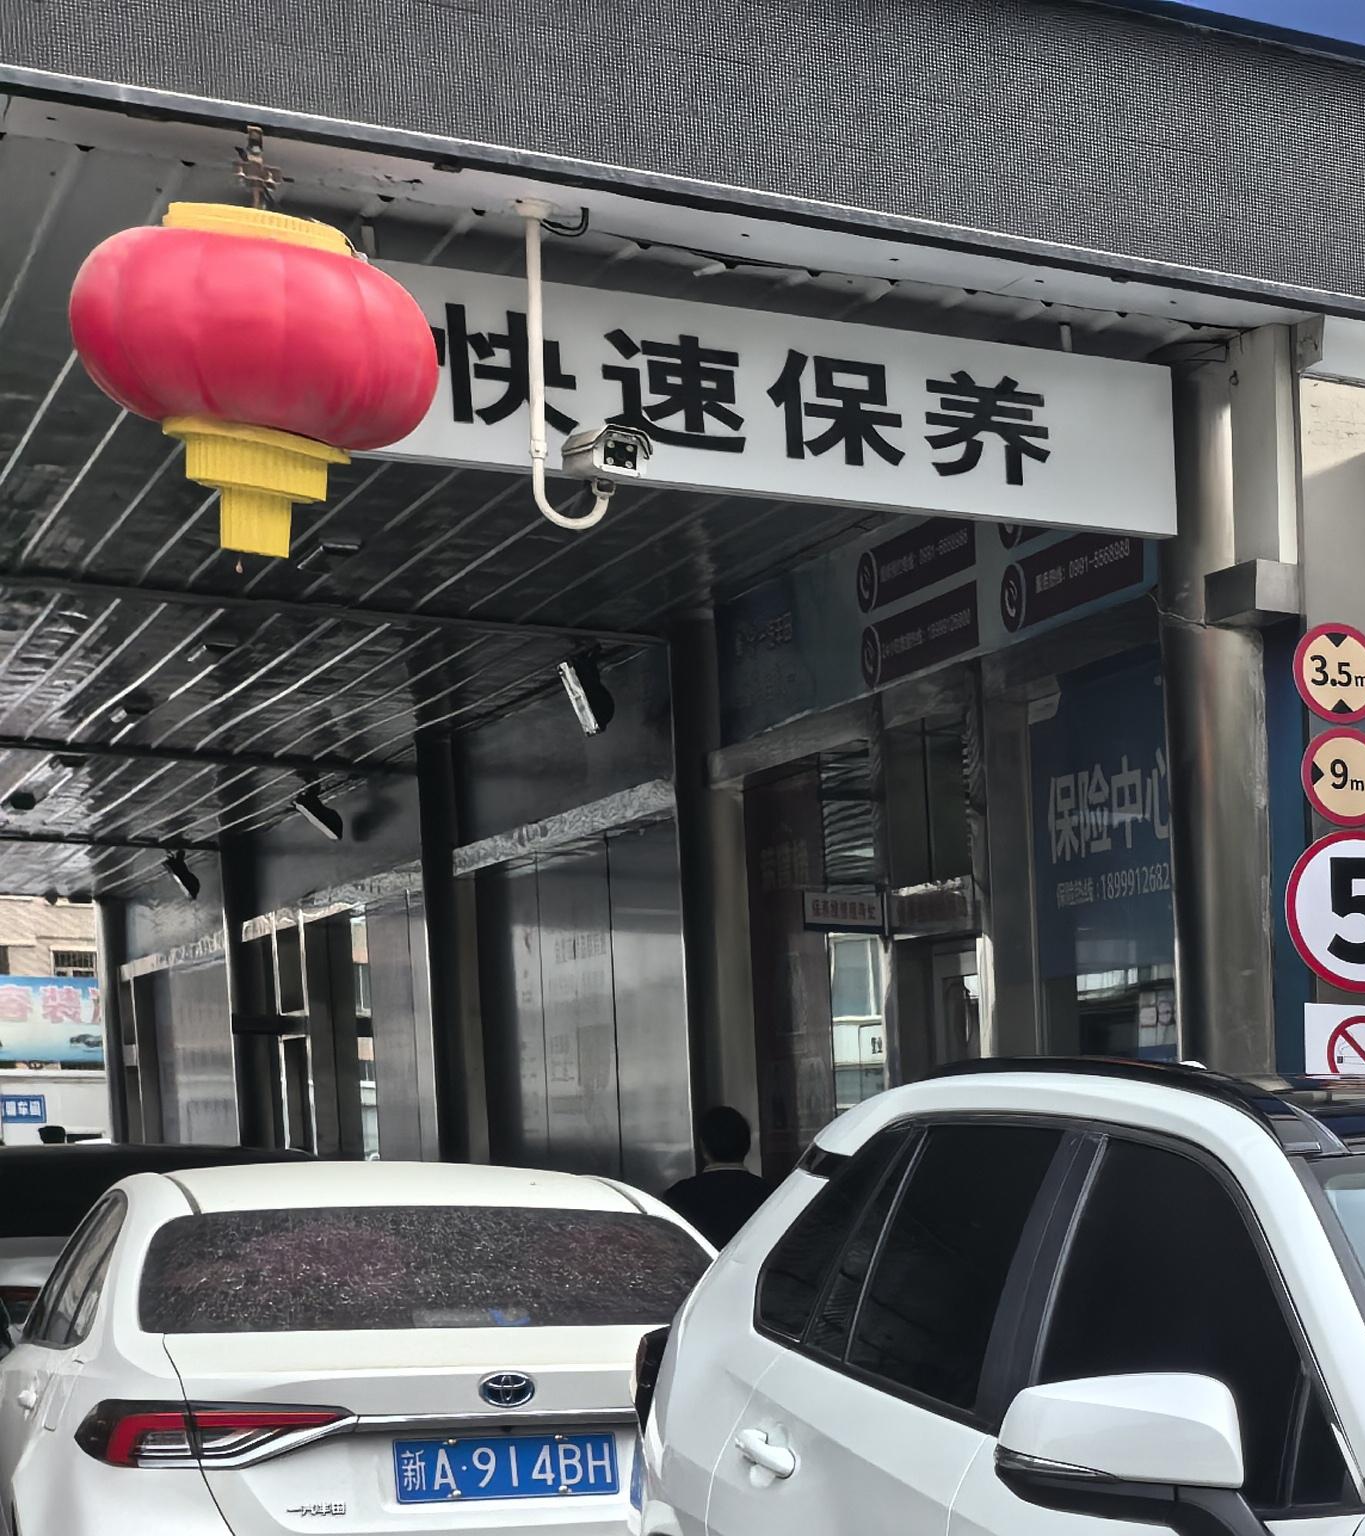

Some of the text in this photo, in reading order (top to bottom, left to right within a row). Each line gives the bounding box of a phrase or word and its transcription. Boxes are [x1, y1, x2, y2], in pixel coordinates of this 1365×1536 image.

[431, 301, 1051, 486] 快速保养
[1047, 746, 1170, 864] 保险中心
[1329, 758, 1365, 792] 9m
